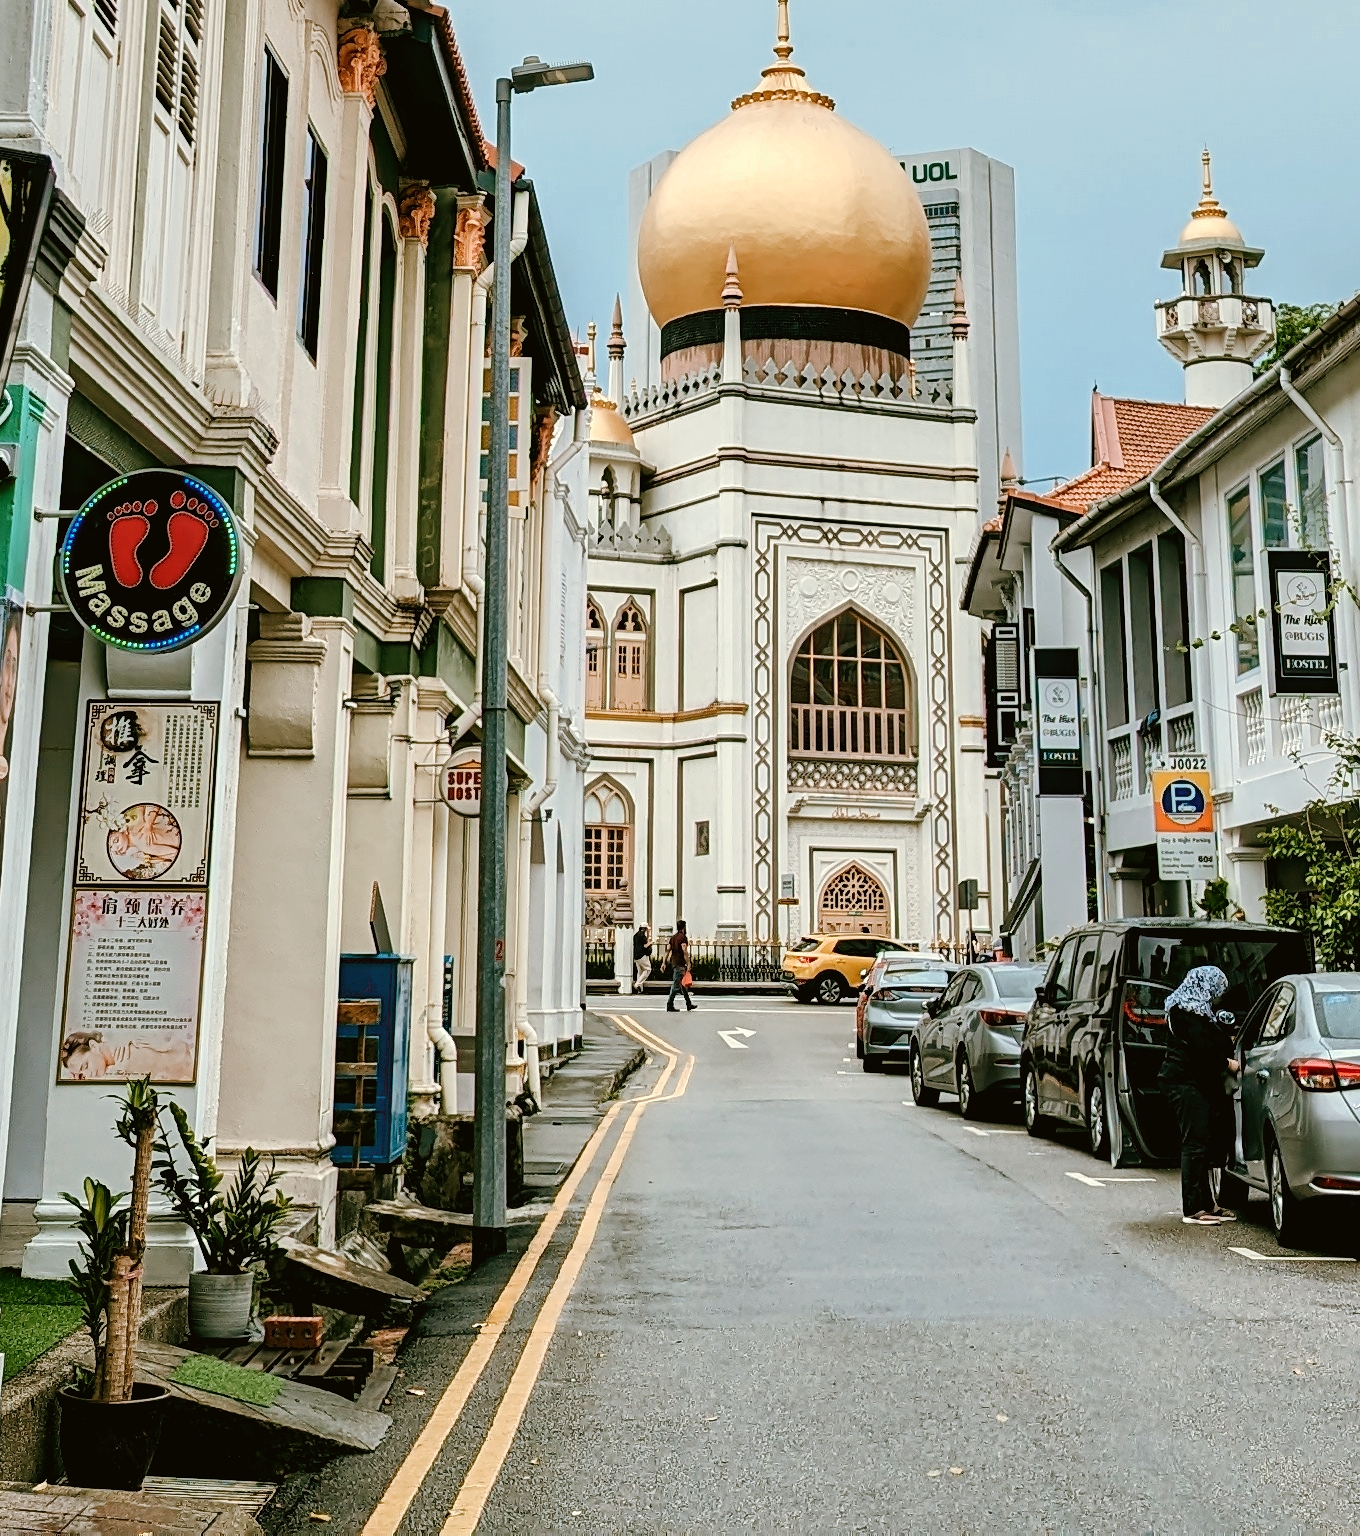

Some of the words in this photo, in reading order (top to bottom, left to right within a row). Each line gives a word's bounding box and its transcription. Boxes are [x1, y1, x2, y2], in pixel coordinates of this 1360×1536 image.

[912, 161, 957, 183] UOL
[75, 564, 212, 634] Massage
[1283, 614, 1301, 625] The
[1285, 631, 1325, 641] @BUGIS
[1286, 658, 1329, 669] HOSTEL
[1170, 758, 1207, 770] J0022
[448, 772, 482, 785] SUPE
[448, 787, 481, 800] HOST
[116, 916, 170, 929] 十三大好处
[495, 939, 503, 959] 2
